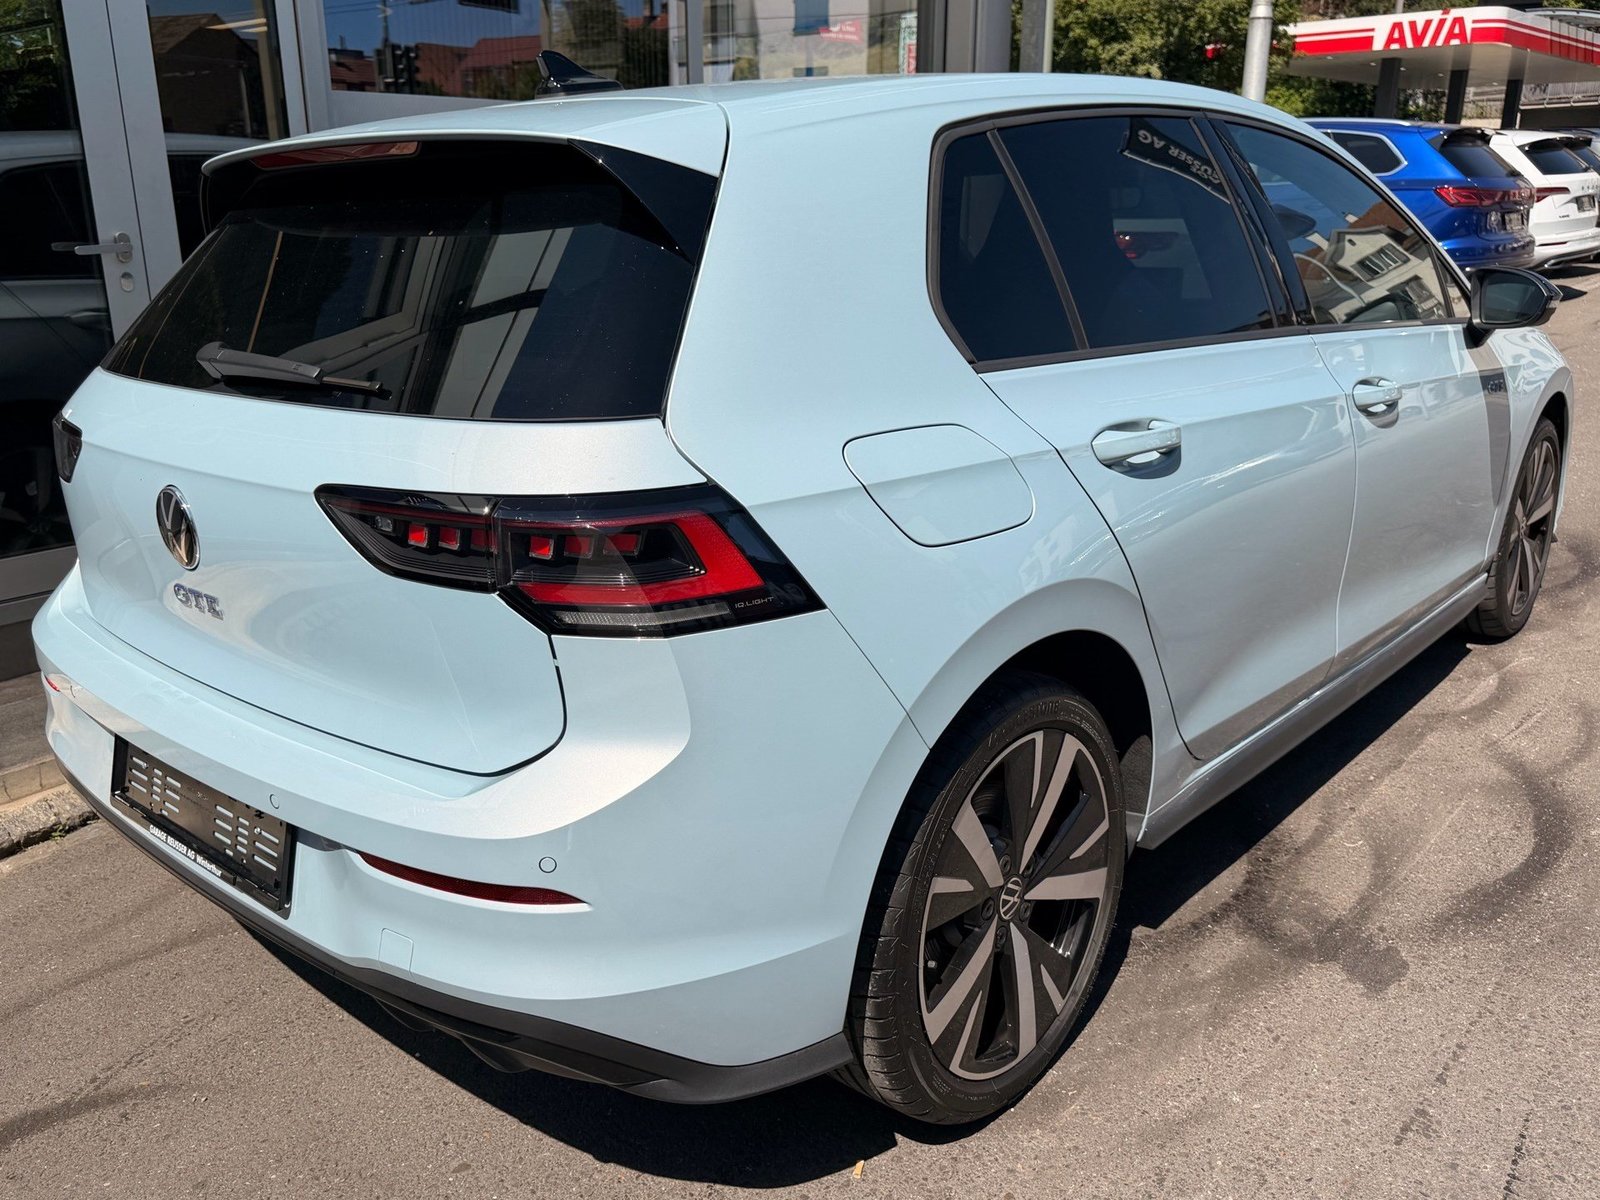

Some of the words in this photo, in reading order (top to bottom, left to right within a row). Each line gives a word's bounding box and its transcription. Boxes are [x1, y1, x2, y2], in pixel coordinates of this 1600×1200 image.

[173, 583, 224, 621] GTE
[734, 596, 775, 609] IQ.LIGHT
[149, 824, 167, 842] GARAGE
[167, 836, 187, 855] REUSSER
[186, 848, 195, 860] AG
[195, 853, 222, 877] Winterthur
